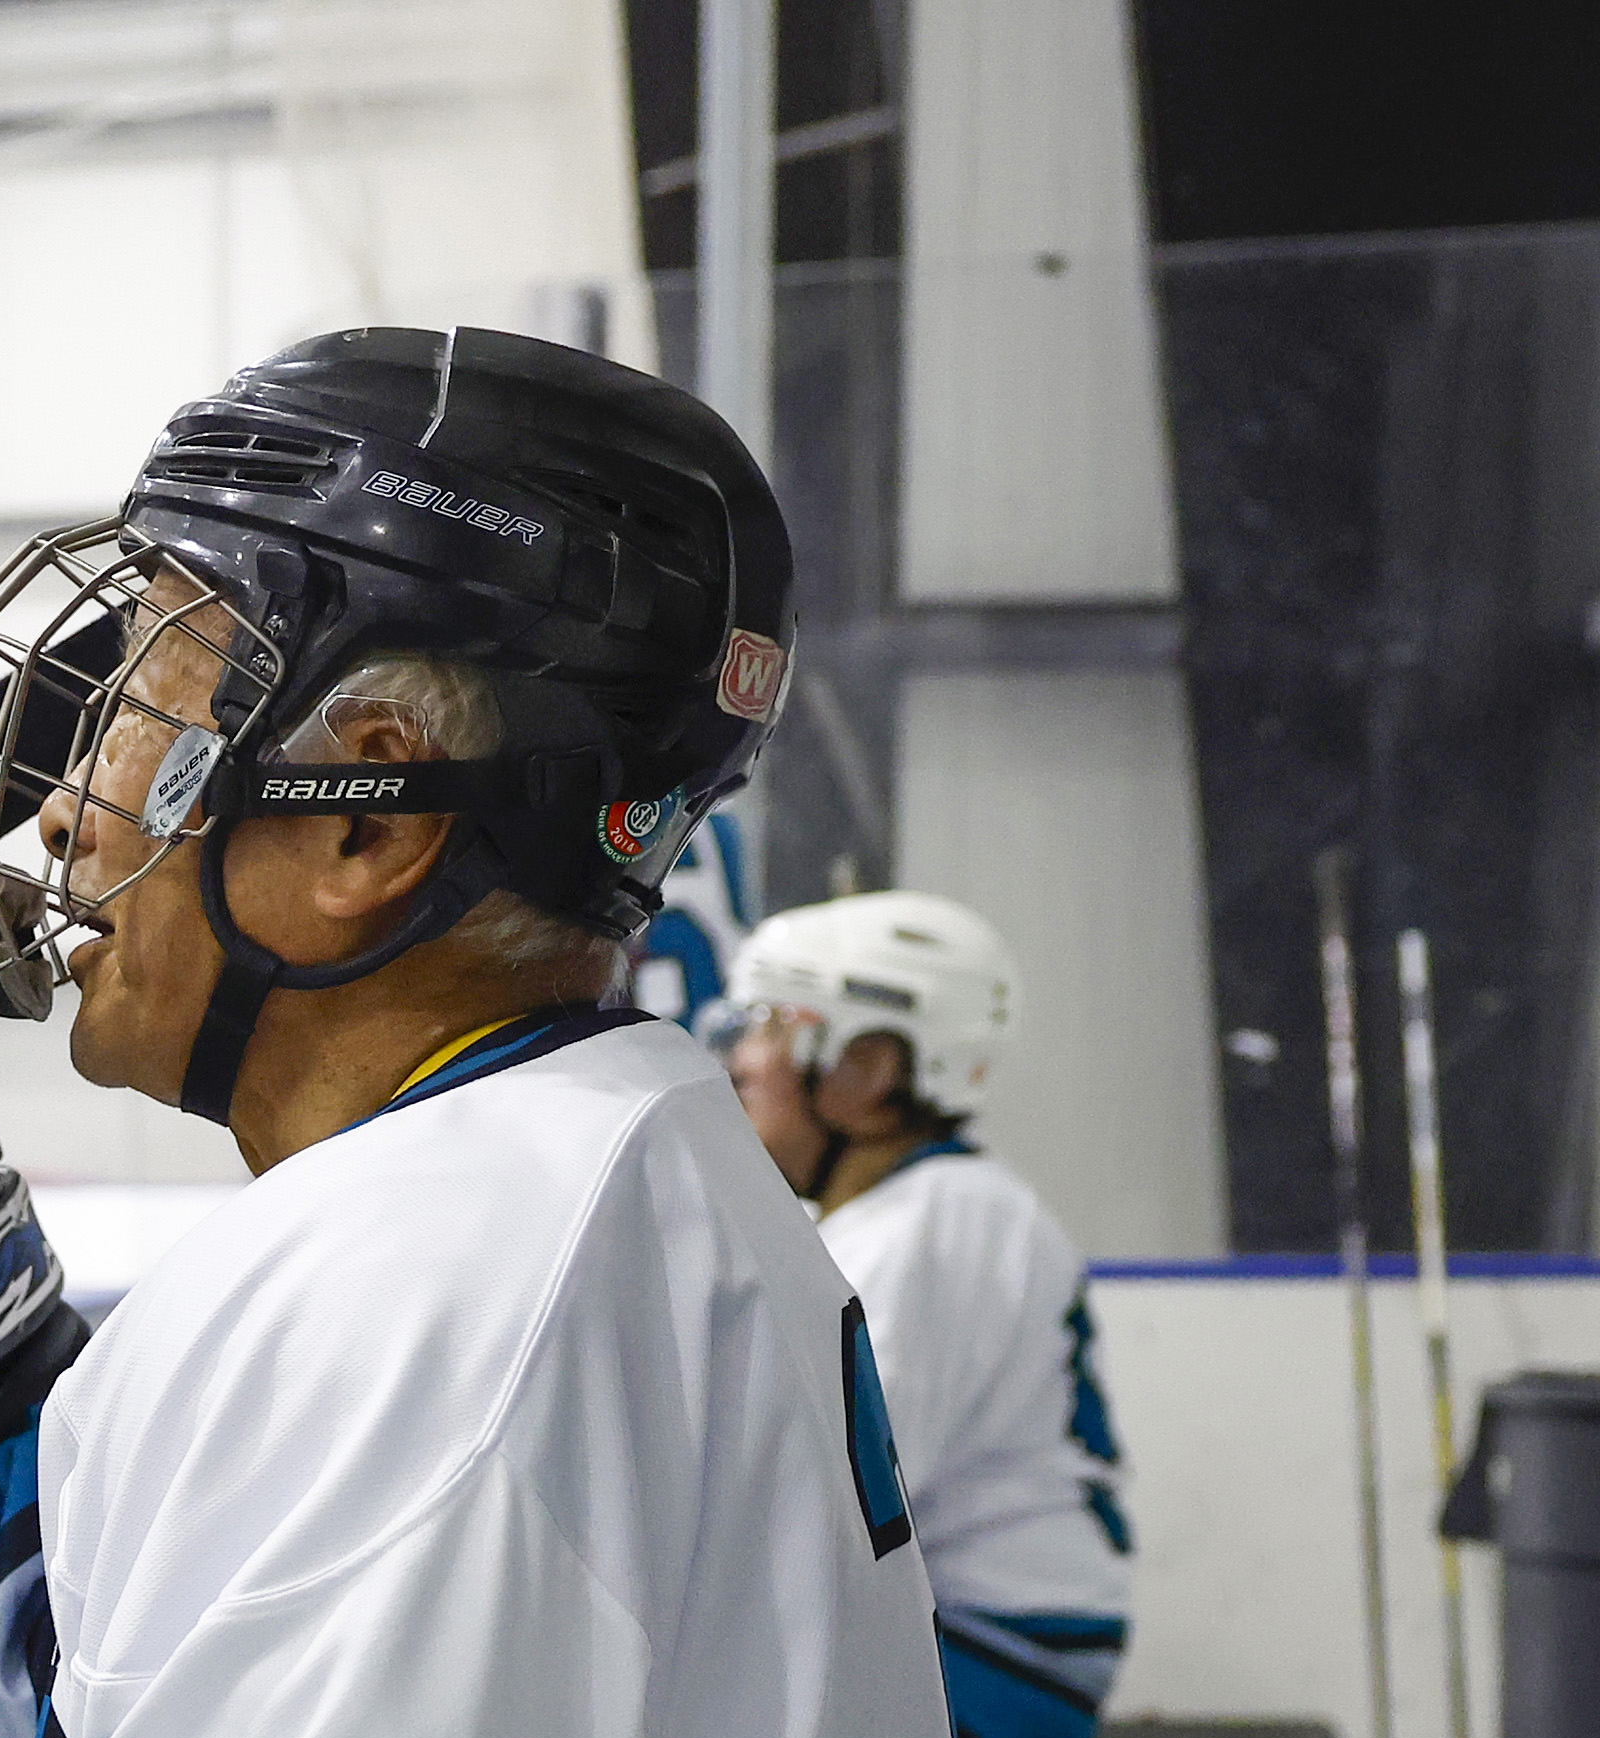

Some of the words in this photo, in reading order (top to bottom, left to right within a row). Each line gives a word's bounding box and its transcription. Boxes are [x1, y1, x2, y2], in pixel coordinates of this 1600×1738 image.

[360, 470, 545, 546] BAUER
[158, 746, 211, 798] BAUER
[261, 777, 406, 801] BAUER
[609, 826, 636, 853] 2014
